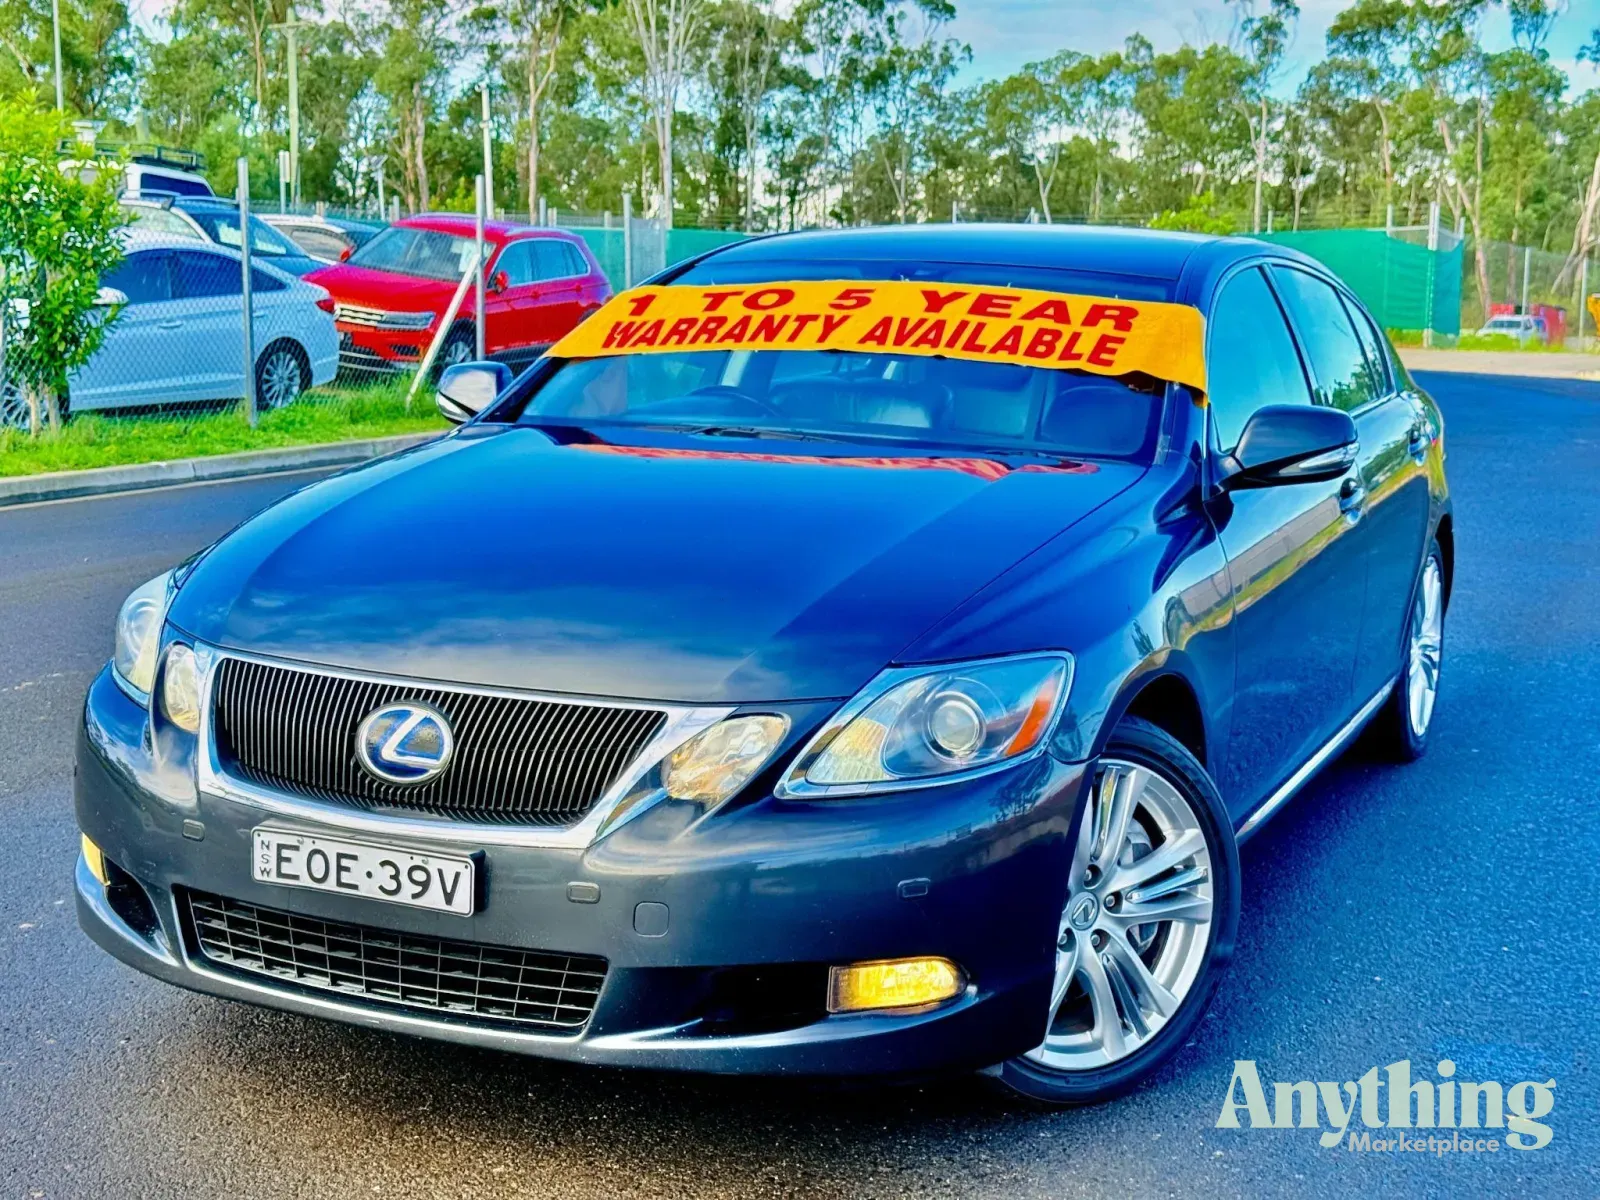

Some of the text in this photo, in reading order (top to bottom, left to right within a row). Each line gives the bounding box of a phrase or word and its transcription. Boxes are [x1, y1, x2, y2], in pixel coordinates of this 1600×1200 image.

[628, 288, 1140, 333] 1 TO 5 YEAR
[601, 314, 1127, 367] WARRANTY AVAILABLE
